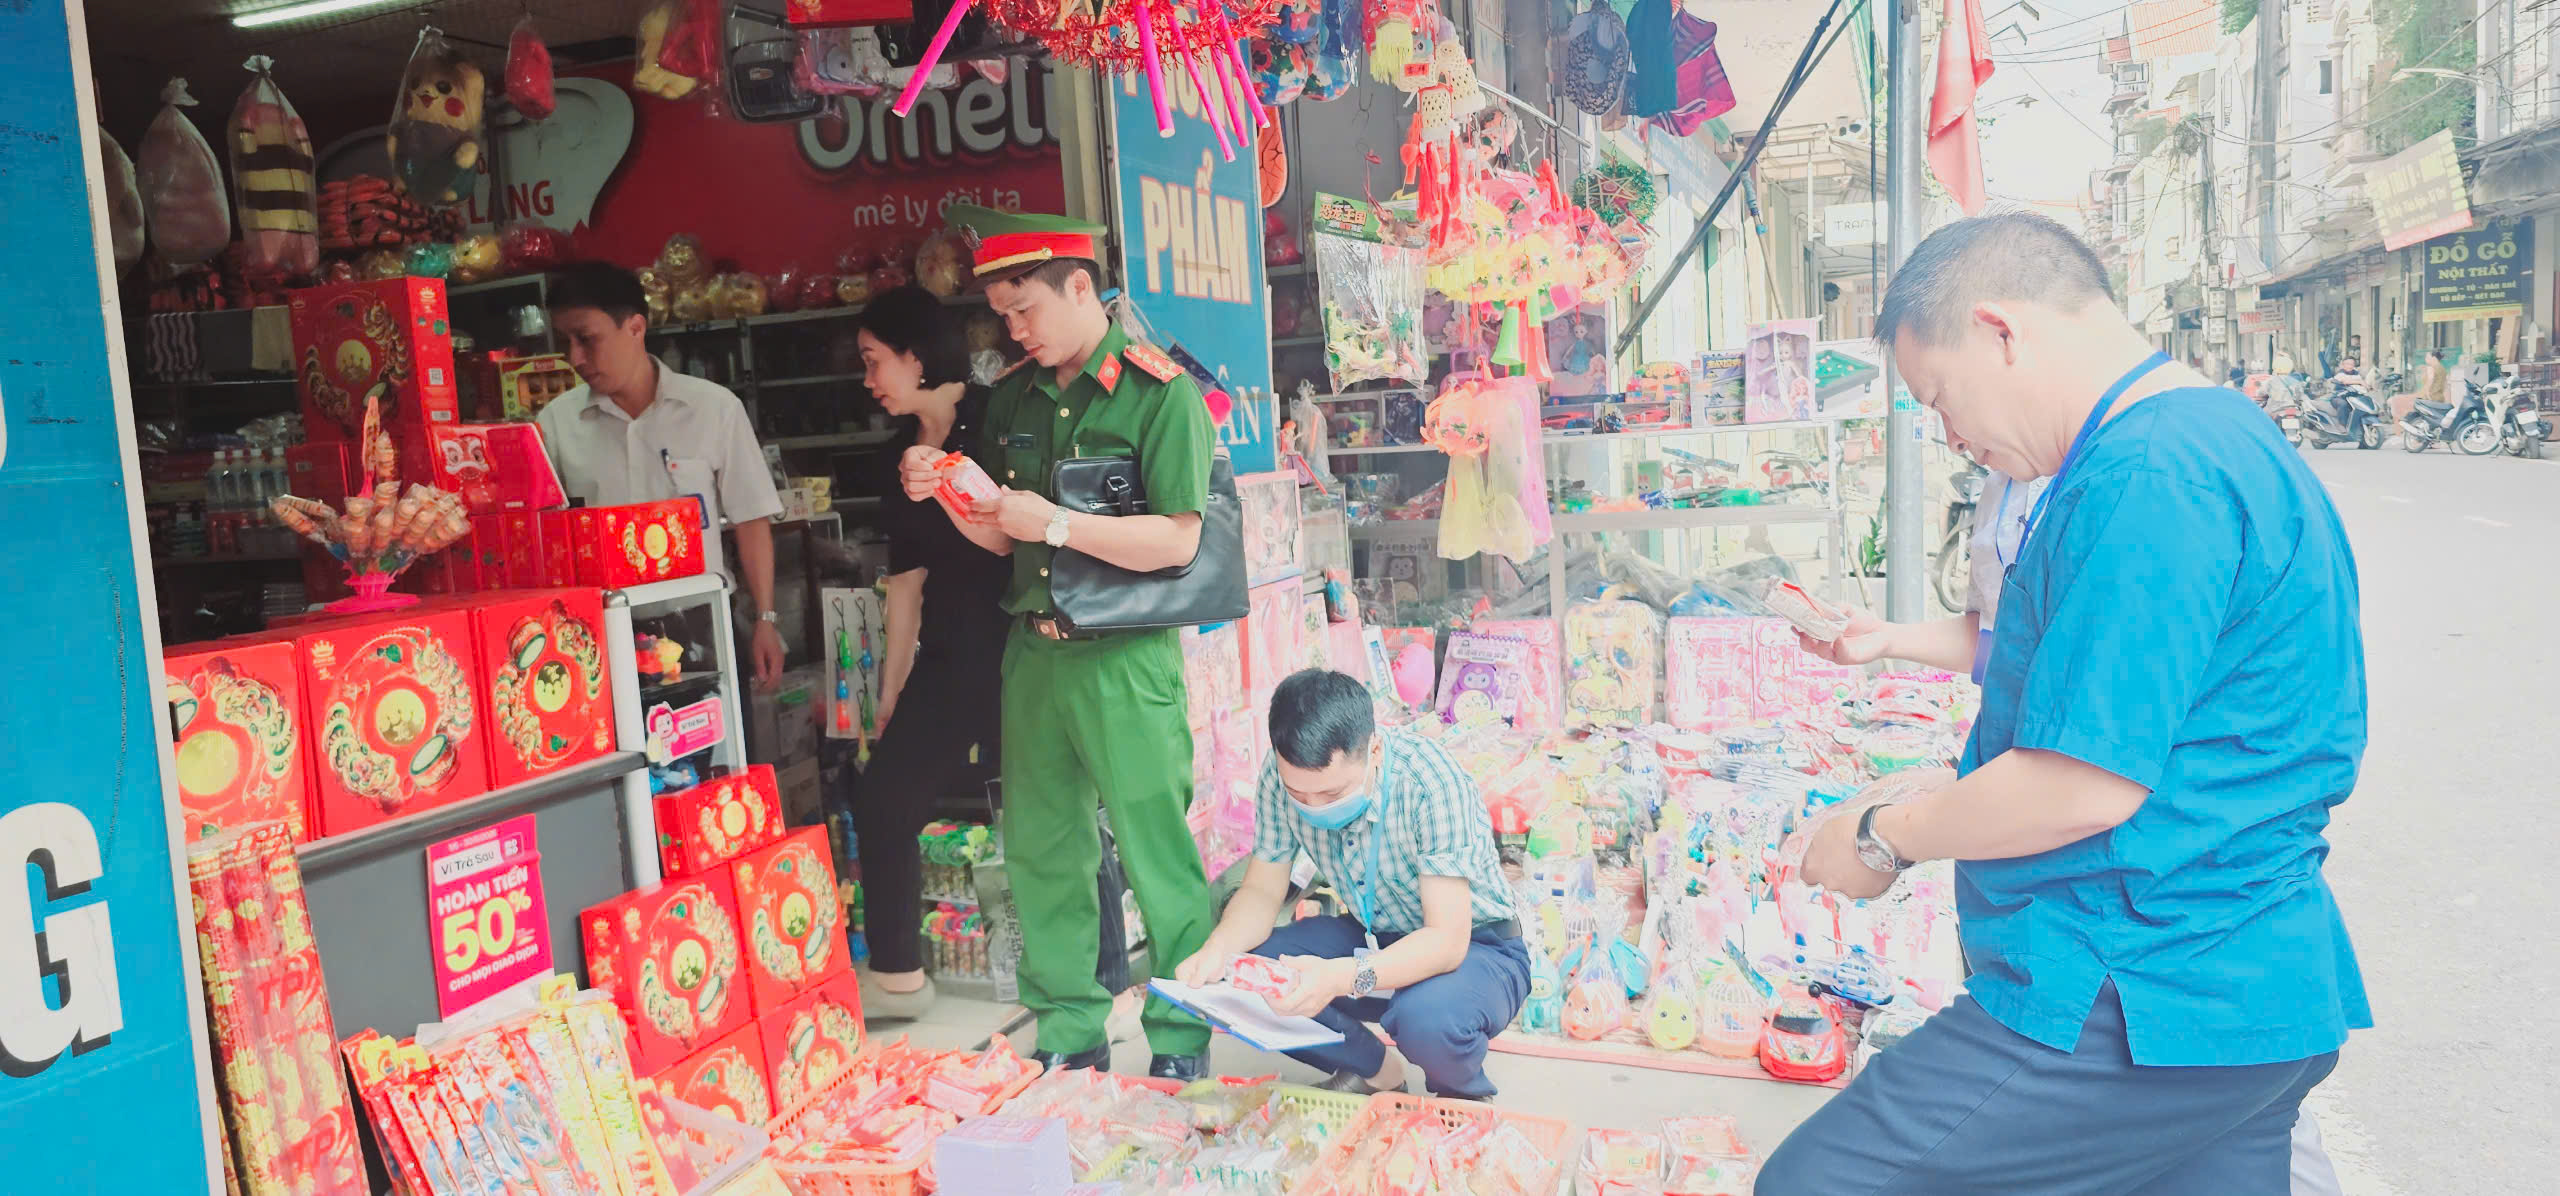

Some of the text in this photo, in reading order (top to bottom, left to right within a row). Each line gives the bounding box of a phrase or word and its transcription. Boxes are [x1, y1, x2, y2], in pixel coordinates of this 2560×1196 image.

[854, 194, 897, 227] mê
[904, 196, 929, 229] ly
[993, 188, 1021, 211] ta
[1141, 148, 1252, 304] PHẨM
[2477, 232, 2517, 261] GỖ
[437, 881, 491, 916] HOÀN
[0, 803, 124, 1064] G
[450, 974, 472, 992] CHO
[492, 954, 515, 972] GIAO
